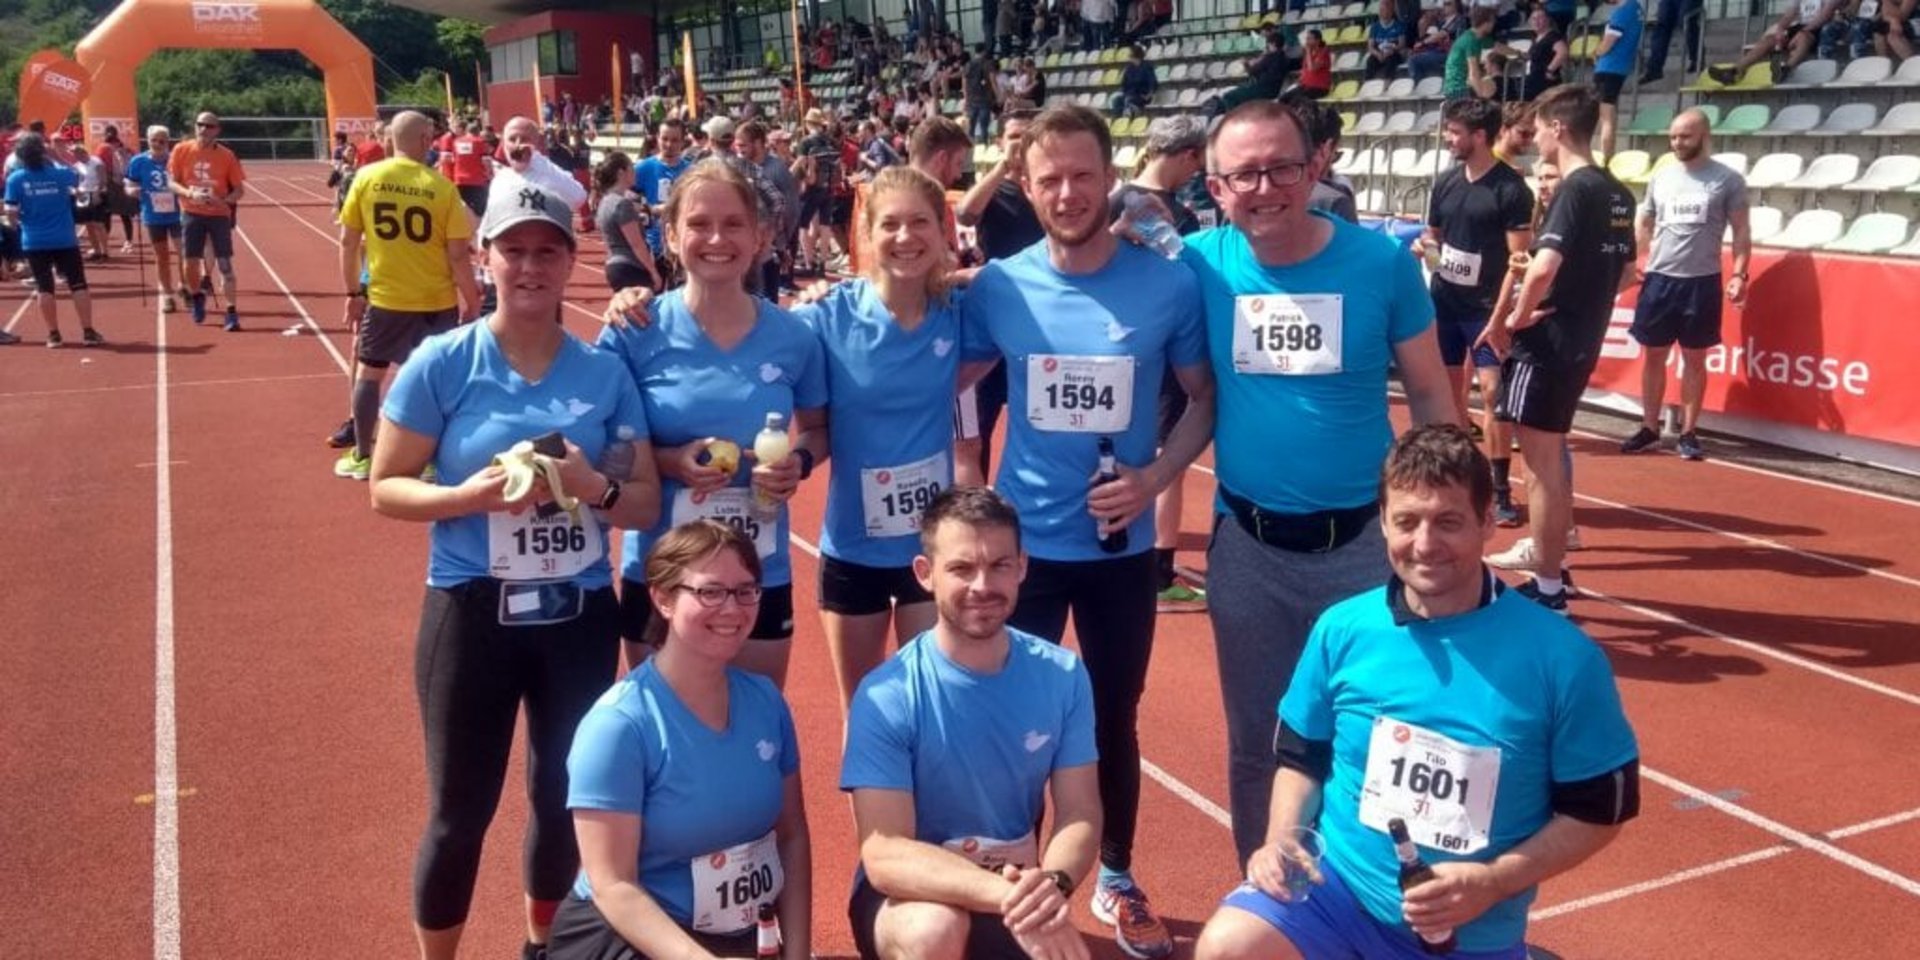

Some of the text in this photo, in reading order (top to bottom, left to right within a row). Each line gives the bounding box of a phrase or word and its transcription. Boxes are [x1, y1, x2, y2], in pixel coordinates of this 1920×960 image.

[192, 5, 260, 21] DAK
[373, 202, 432, 243] 50
[1269, 313, 1302, 322] Patrick
[1252, 323, 1322, 351] 1598
[1277, 355, 1290, 369] 31
[1666, 337, 1870, 395] arkasse
[1046, 384, 1115, 411] 1594
[1069, 414, 1083, 426] 31
[512, 526, 586, 555] 1596
[541, 558, 556, 571] 31
[1425, 751, 1447, 766] Tilo
[1391, 756, 1469, 805] 1601
[1412, 800, 1430, 815] 31
[1433, 832, 1469, 850] 1601
[716, 863, 773, 909] 1600
